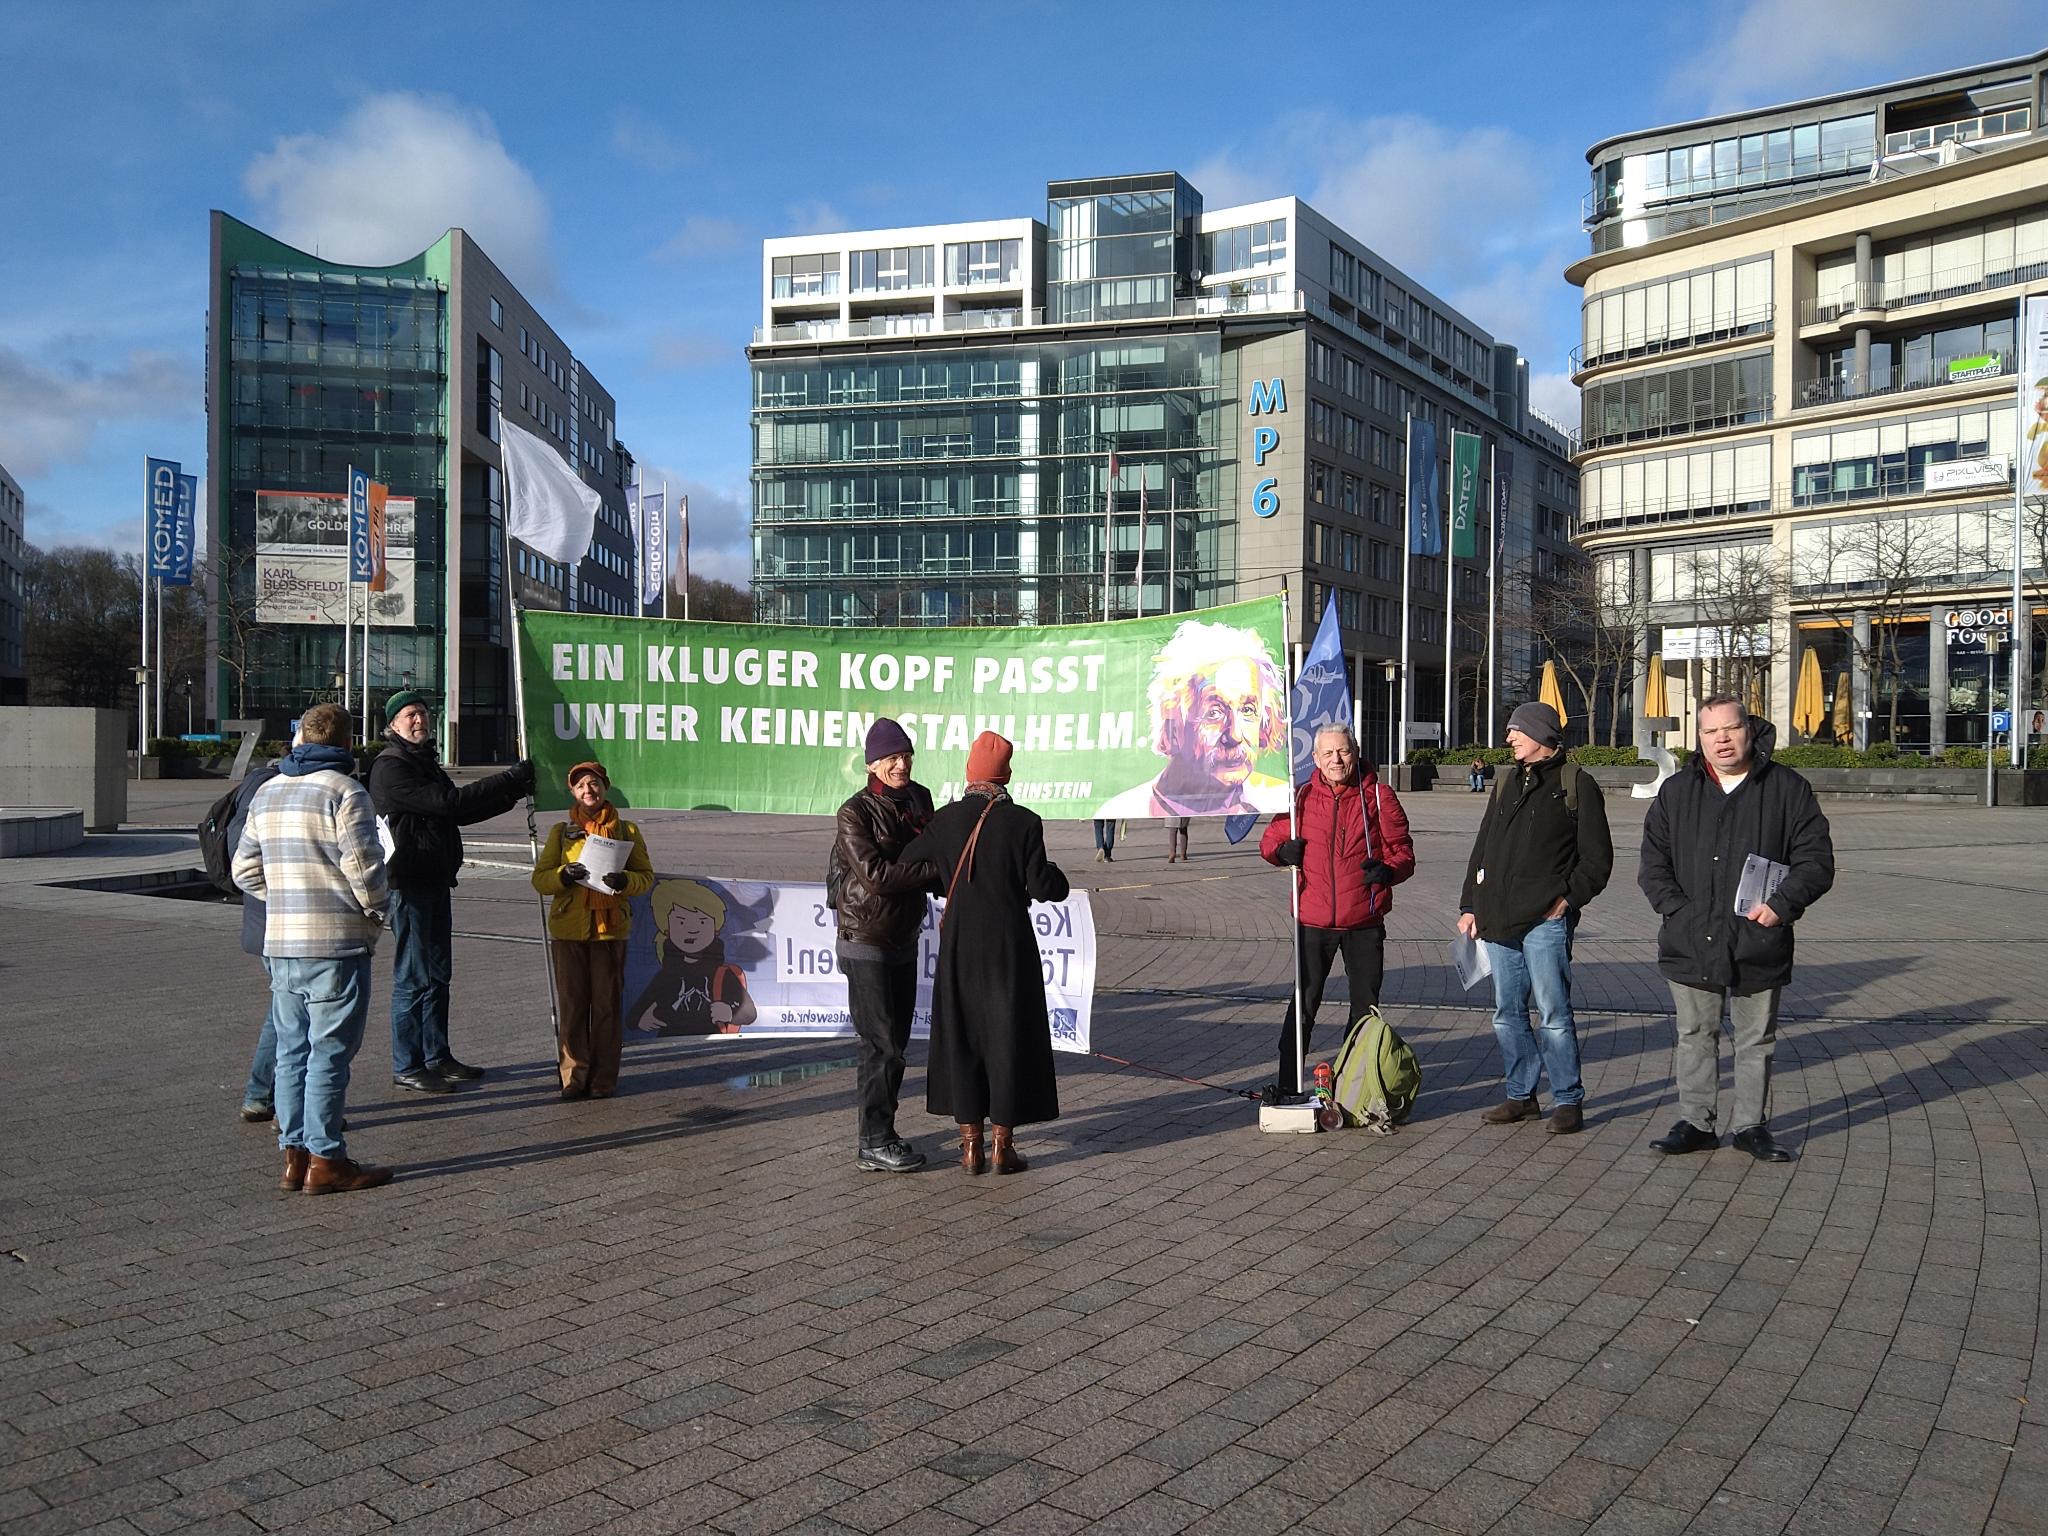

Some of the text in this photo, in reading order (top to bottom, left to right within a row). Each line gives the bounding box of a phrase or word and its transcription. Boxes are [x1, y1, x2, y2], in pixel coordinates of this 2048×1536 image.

[1952, 366, 2000, 379] STARTPLATZ
[1455, 464, 1471, 530] DATEV
[153, 466, 174, 570] KOMED
[307, 520, 409, 533] GOLDE HRE
[354, 475, 370, 575] KOMED
[263, 568, 297, 579] KARL
[263, 579, 345, 592] BLOSSFELDT
[552, 643, 1105, 694] EIN KLUGER KOPF PASST
[553, 703, 699, 742] UNTER
[720, 705, 874, 747] KEINEN
[1012, 782, 1092, 799] EINSTEIN
